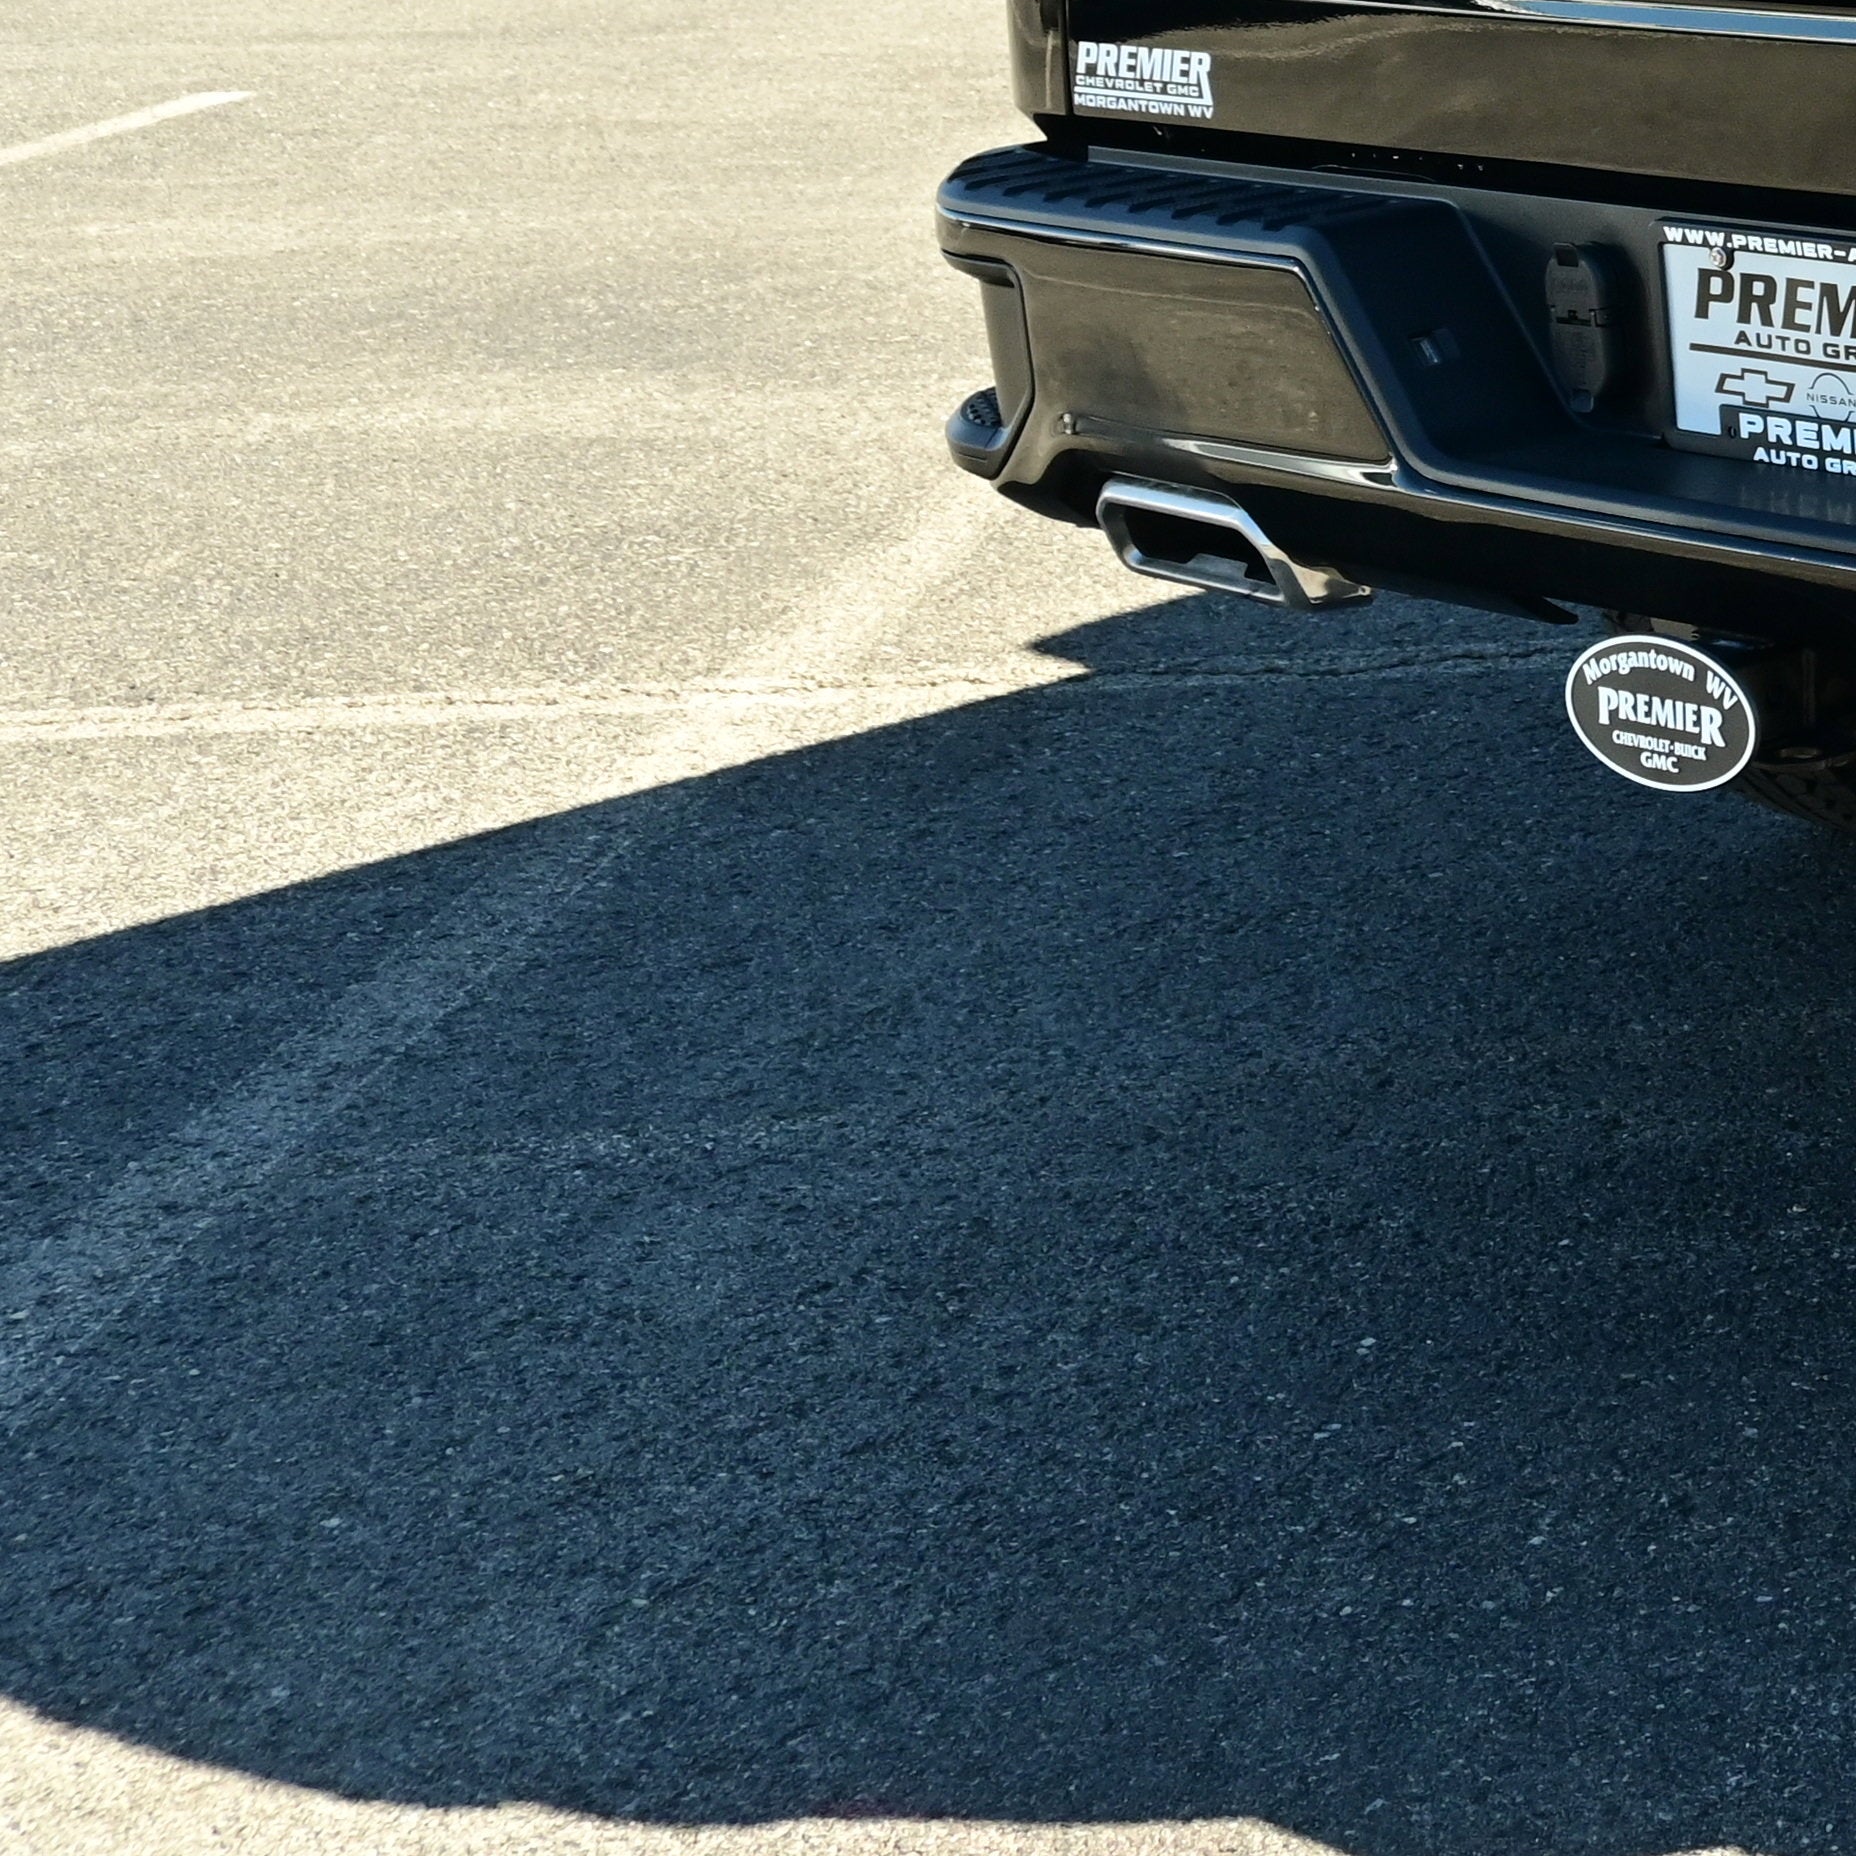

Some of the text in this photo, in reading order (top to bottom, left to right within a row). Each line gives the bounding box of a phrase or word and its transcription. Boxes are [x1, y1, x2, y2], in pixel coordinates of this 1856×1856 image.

[1076, 40, 1212, 87] PREMIER
[1075, 74, 1200, 97] CHEVROLET GMC
[1074, 93, 1214, 120] MORGANTOWN WV
[1734, 330, 1811, 356] AUTO
[1806, 392, 1856, 408] NISSAN
[1753, 446, 1819, 471] AUTO
[1582, 649, 1739, 710] Morgantown WV
[1597, 685, 1726, 748] PREMIER
[1640, 751, 1680, 774] GMC
